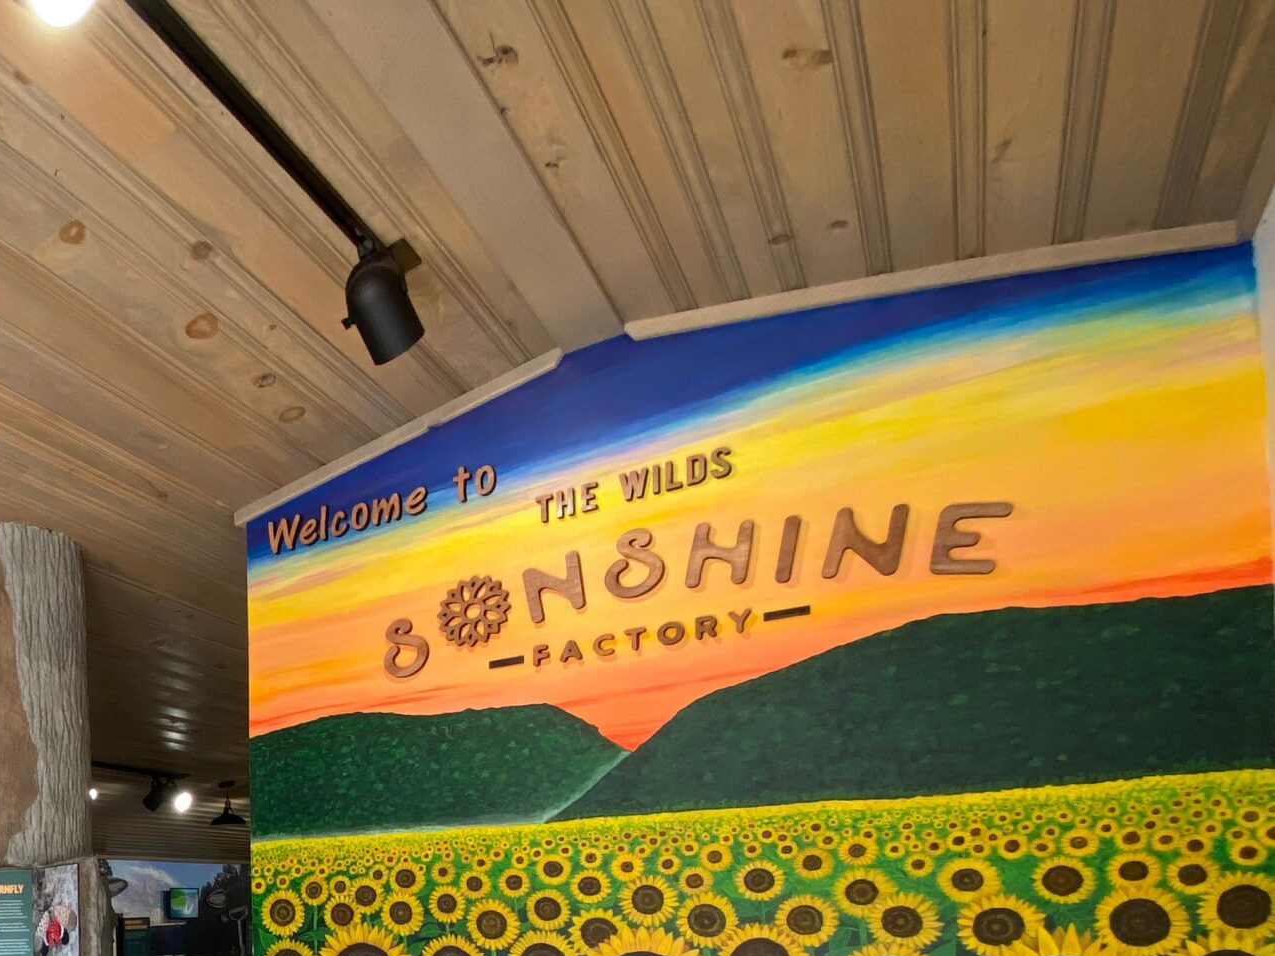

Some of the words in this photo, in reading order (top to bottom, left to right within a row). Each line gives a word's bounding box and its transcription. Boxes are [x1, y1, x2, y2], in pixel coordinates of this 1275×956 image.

[266, 486, 428, 555] Welcome
[452, 462, 497, 505] to
[536, 479, 599, 523] THE
[619, 446, 734, 504] WILDS
[532, 606, 753, 668] FACTORY
